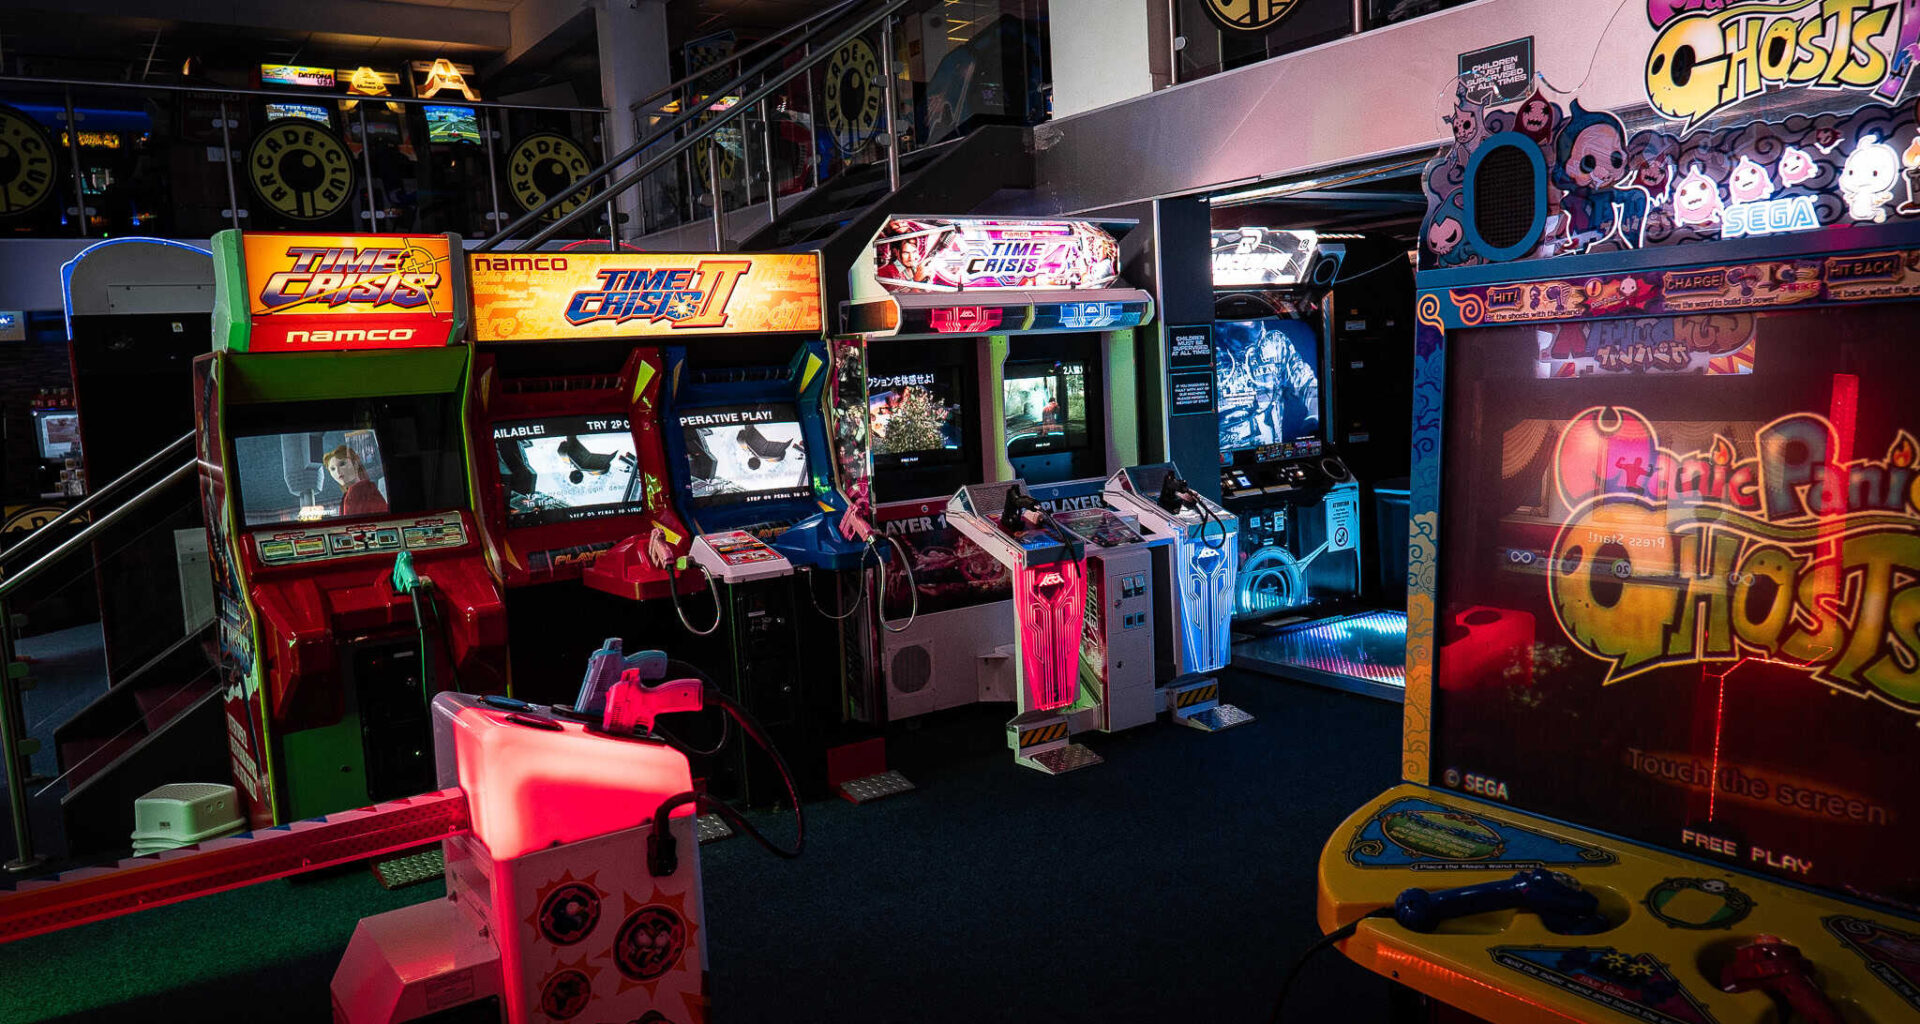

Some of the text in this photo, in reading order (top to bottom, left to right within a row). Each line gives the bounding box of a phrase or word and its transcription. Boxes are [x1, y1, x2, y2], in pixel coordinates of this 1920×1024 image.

[1471, 55, 1518, 72] CHILDREN
[1503, 62, 1516, 71] BE
[1646, 2, 1899, 125] GHOSTS
[298, 71, 332, 81] DAYTONA
[316, 79, 334, 87] USA
[1496, 73, 1527, 86] TIMES
[827, 43, 858, 136] ARCADE
[18, 137, 48, 197] CLUB
[257, 129, 346, 203] ARCADE CLUB
[514, 140, 562, 206] ARCADE
[1724, 200, 1817, 234] SEGA
[991, 241, 1046, 257] TIME
[286, 246, 412, 274] TIME
[474, 257, 568, 272] namco
[965, 243, 1067, 275] CRISIS 4
[597, 268, 695, 291] TIME
[1829, 263, 1853, 278] HIT
[260, 271, 442, 308] CRISIS
[1665, 273, 1726, 290] CHARGE!
[1492, 290, 1518, 304] HIT!
[564, 290, 705, 326] CRISIS
[1508, 312, 1530, 321] ghosts
[1531, 310, 1547, 319] with
[286, 328, 417, 344] namco
[1175, 334, 1205, 342] CHILDREN
[586, 420, 608, 431] TRY
[610, 419, 622, 430] 2P
[679, 410, 773, 427] PERATIVE PLAY!
[1044, 496, 1102, 513] PLAYER
[885, 516, 935, 535] AYER
[1550, 495, 1920, 710] GHOSTS
[1463, 773, 1510, 800] SEGA
[1626, 747, 1888, 826] Touch the screen
[1681, 829, 1815, 875] FREE PLAY
